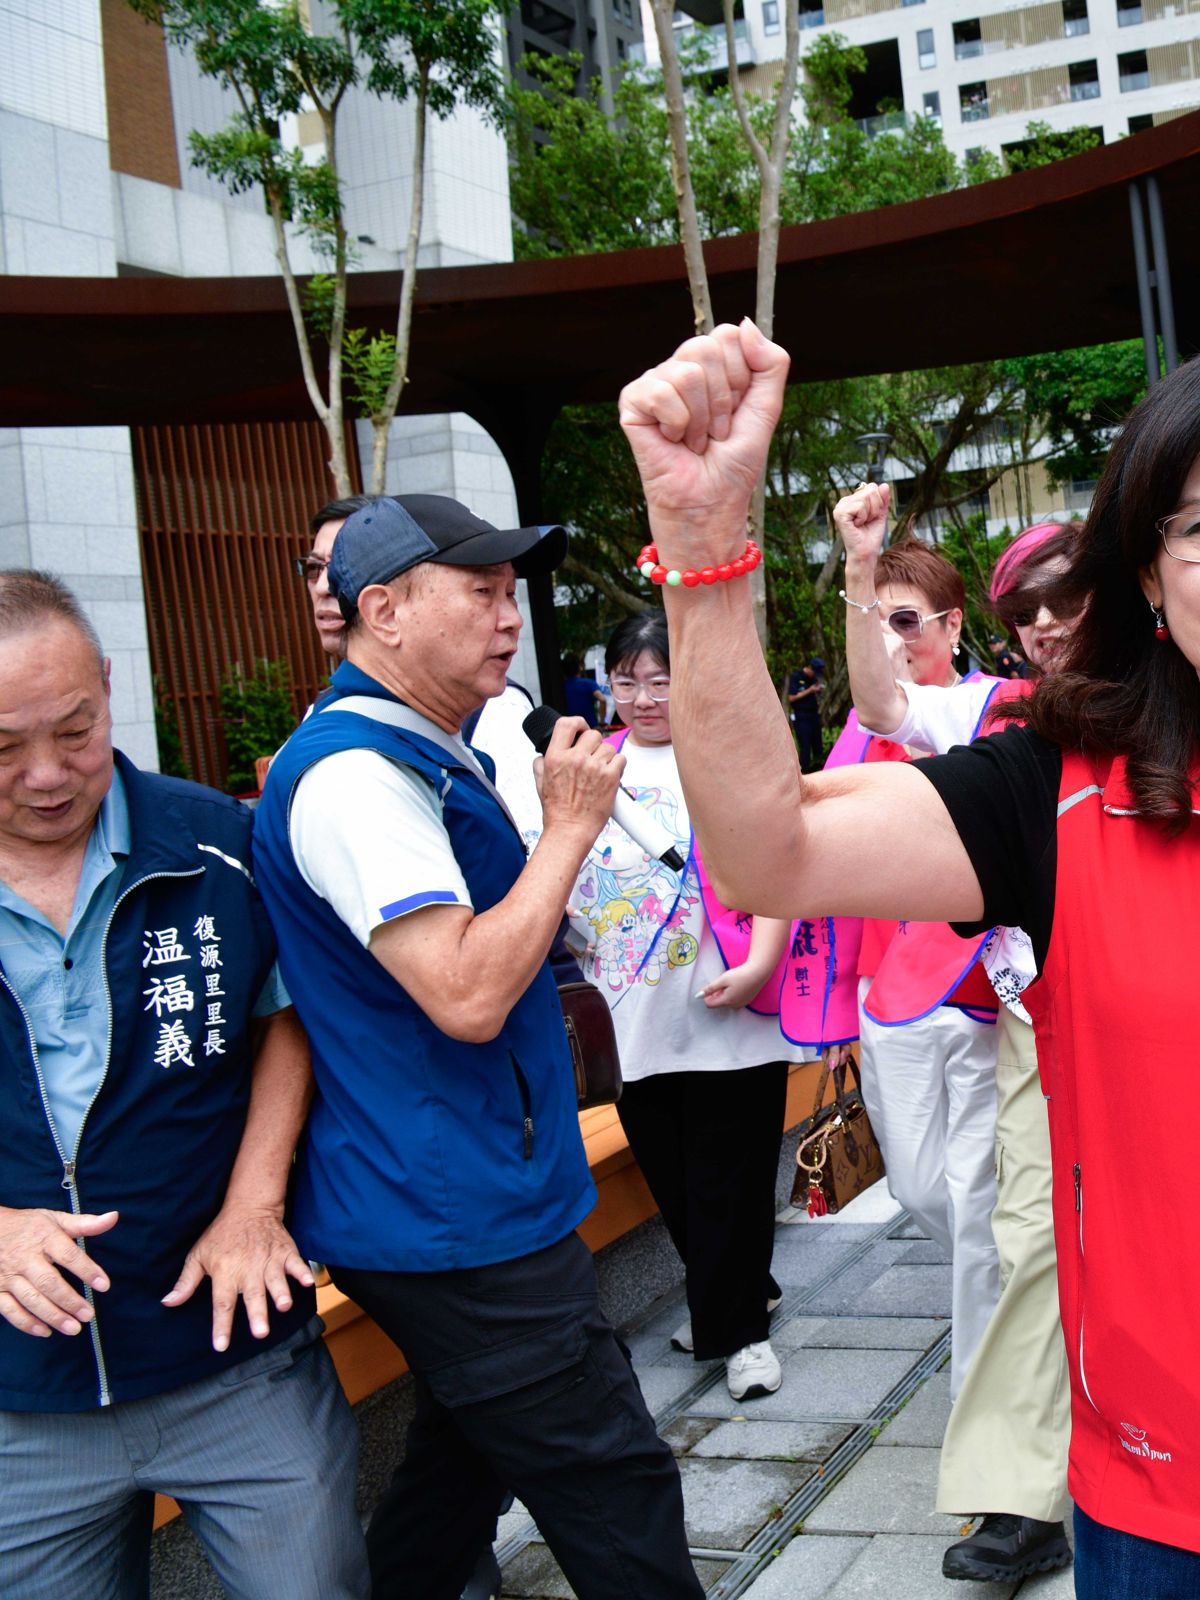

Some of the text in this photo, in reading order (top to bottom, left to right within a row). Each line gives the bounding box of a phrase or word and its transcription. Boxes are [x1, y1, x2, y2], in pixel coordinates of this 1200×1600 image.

[192, 914, 227, 1057] 復源里里長
